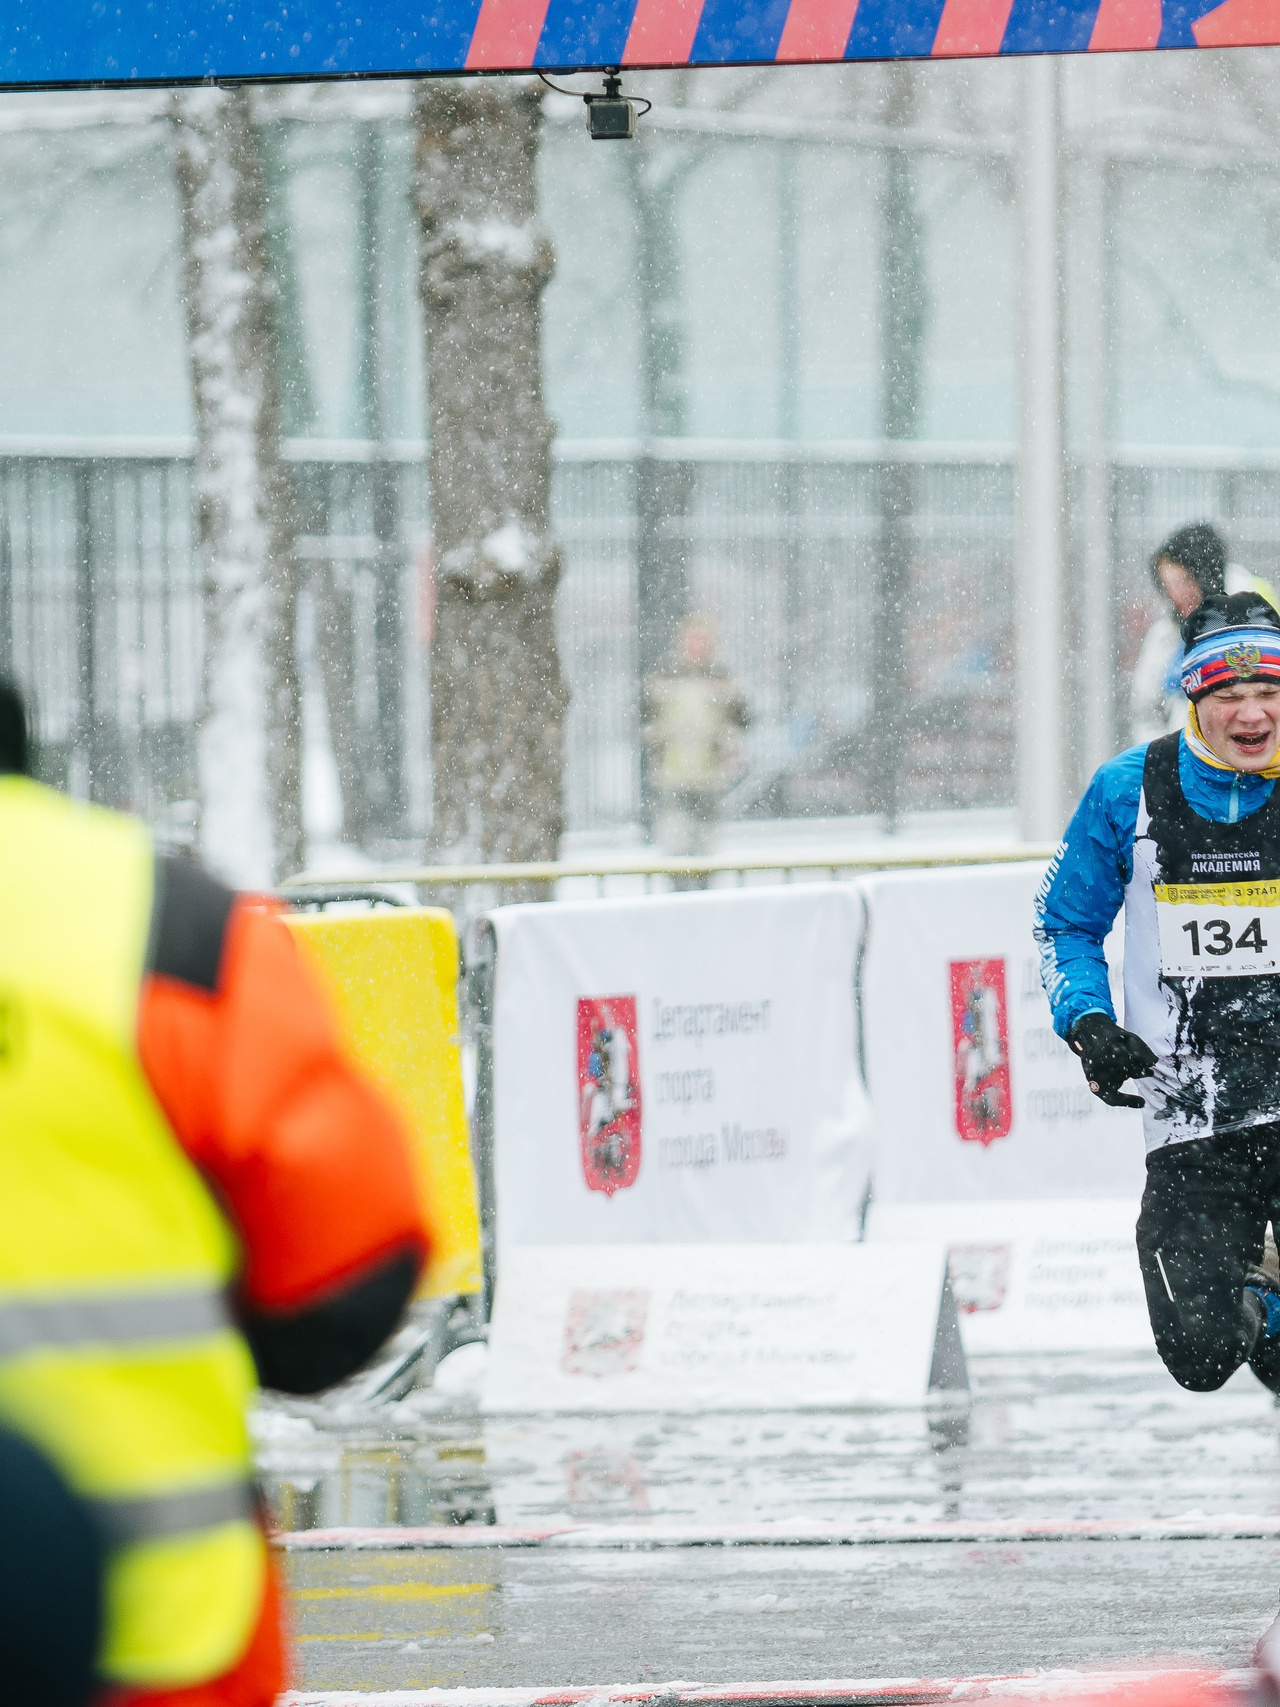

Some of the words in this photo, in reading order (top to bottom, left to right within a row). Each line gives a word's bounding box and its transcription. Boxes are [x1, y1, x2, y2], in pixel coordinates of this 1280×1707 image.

[1190, 850, 1261, 860] ПРЕЗИДЕНТСКАЯ
[1191, 860, 1261, 873] АКАДЕМИЯ
[1235, 889, 1242, 897] 3
[1247, 887, 1278, 897] ЭТАП
[1181, 917, 1268, 956] 134
